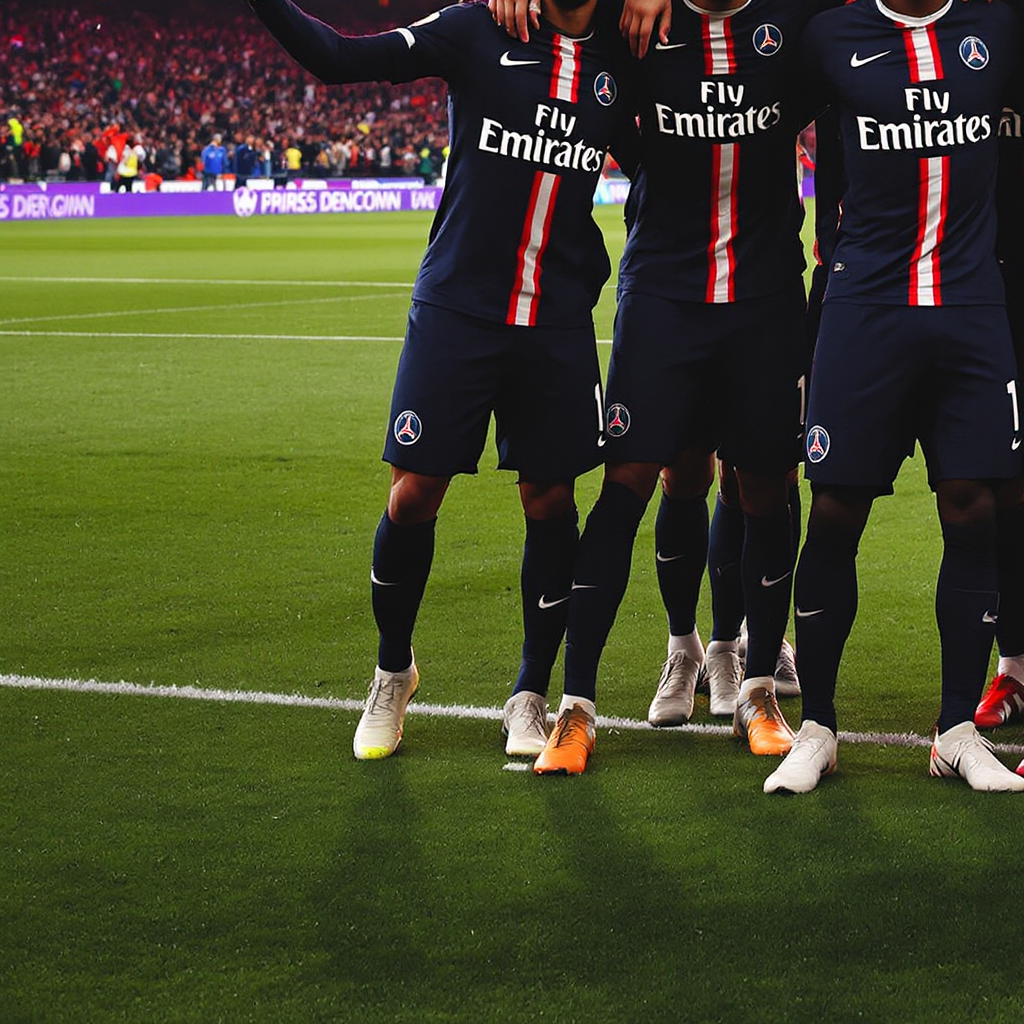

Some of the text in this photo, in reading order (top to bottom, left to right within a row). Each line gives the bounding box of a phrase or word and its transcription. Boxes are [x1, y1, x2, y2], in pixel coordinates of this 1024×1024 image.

[700, 81, 744, 107] Fly
[904, 87, 950, 114] Fly
[534, 103, 577, 136] Fly
[655, 101, 781, 138] Emirates
[856, 114, 991, 150] Emirates
[478, 117, 604, 173] Emirates
